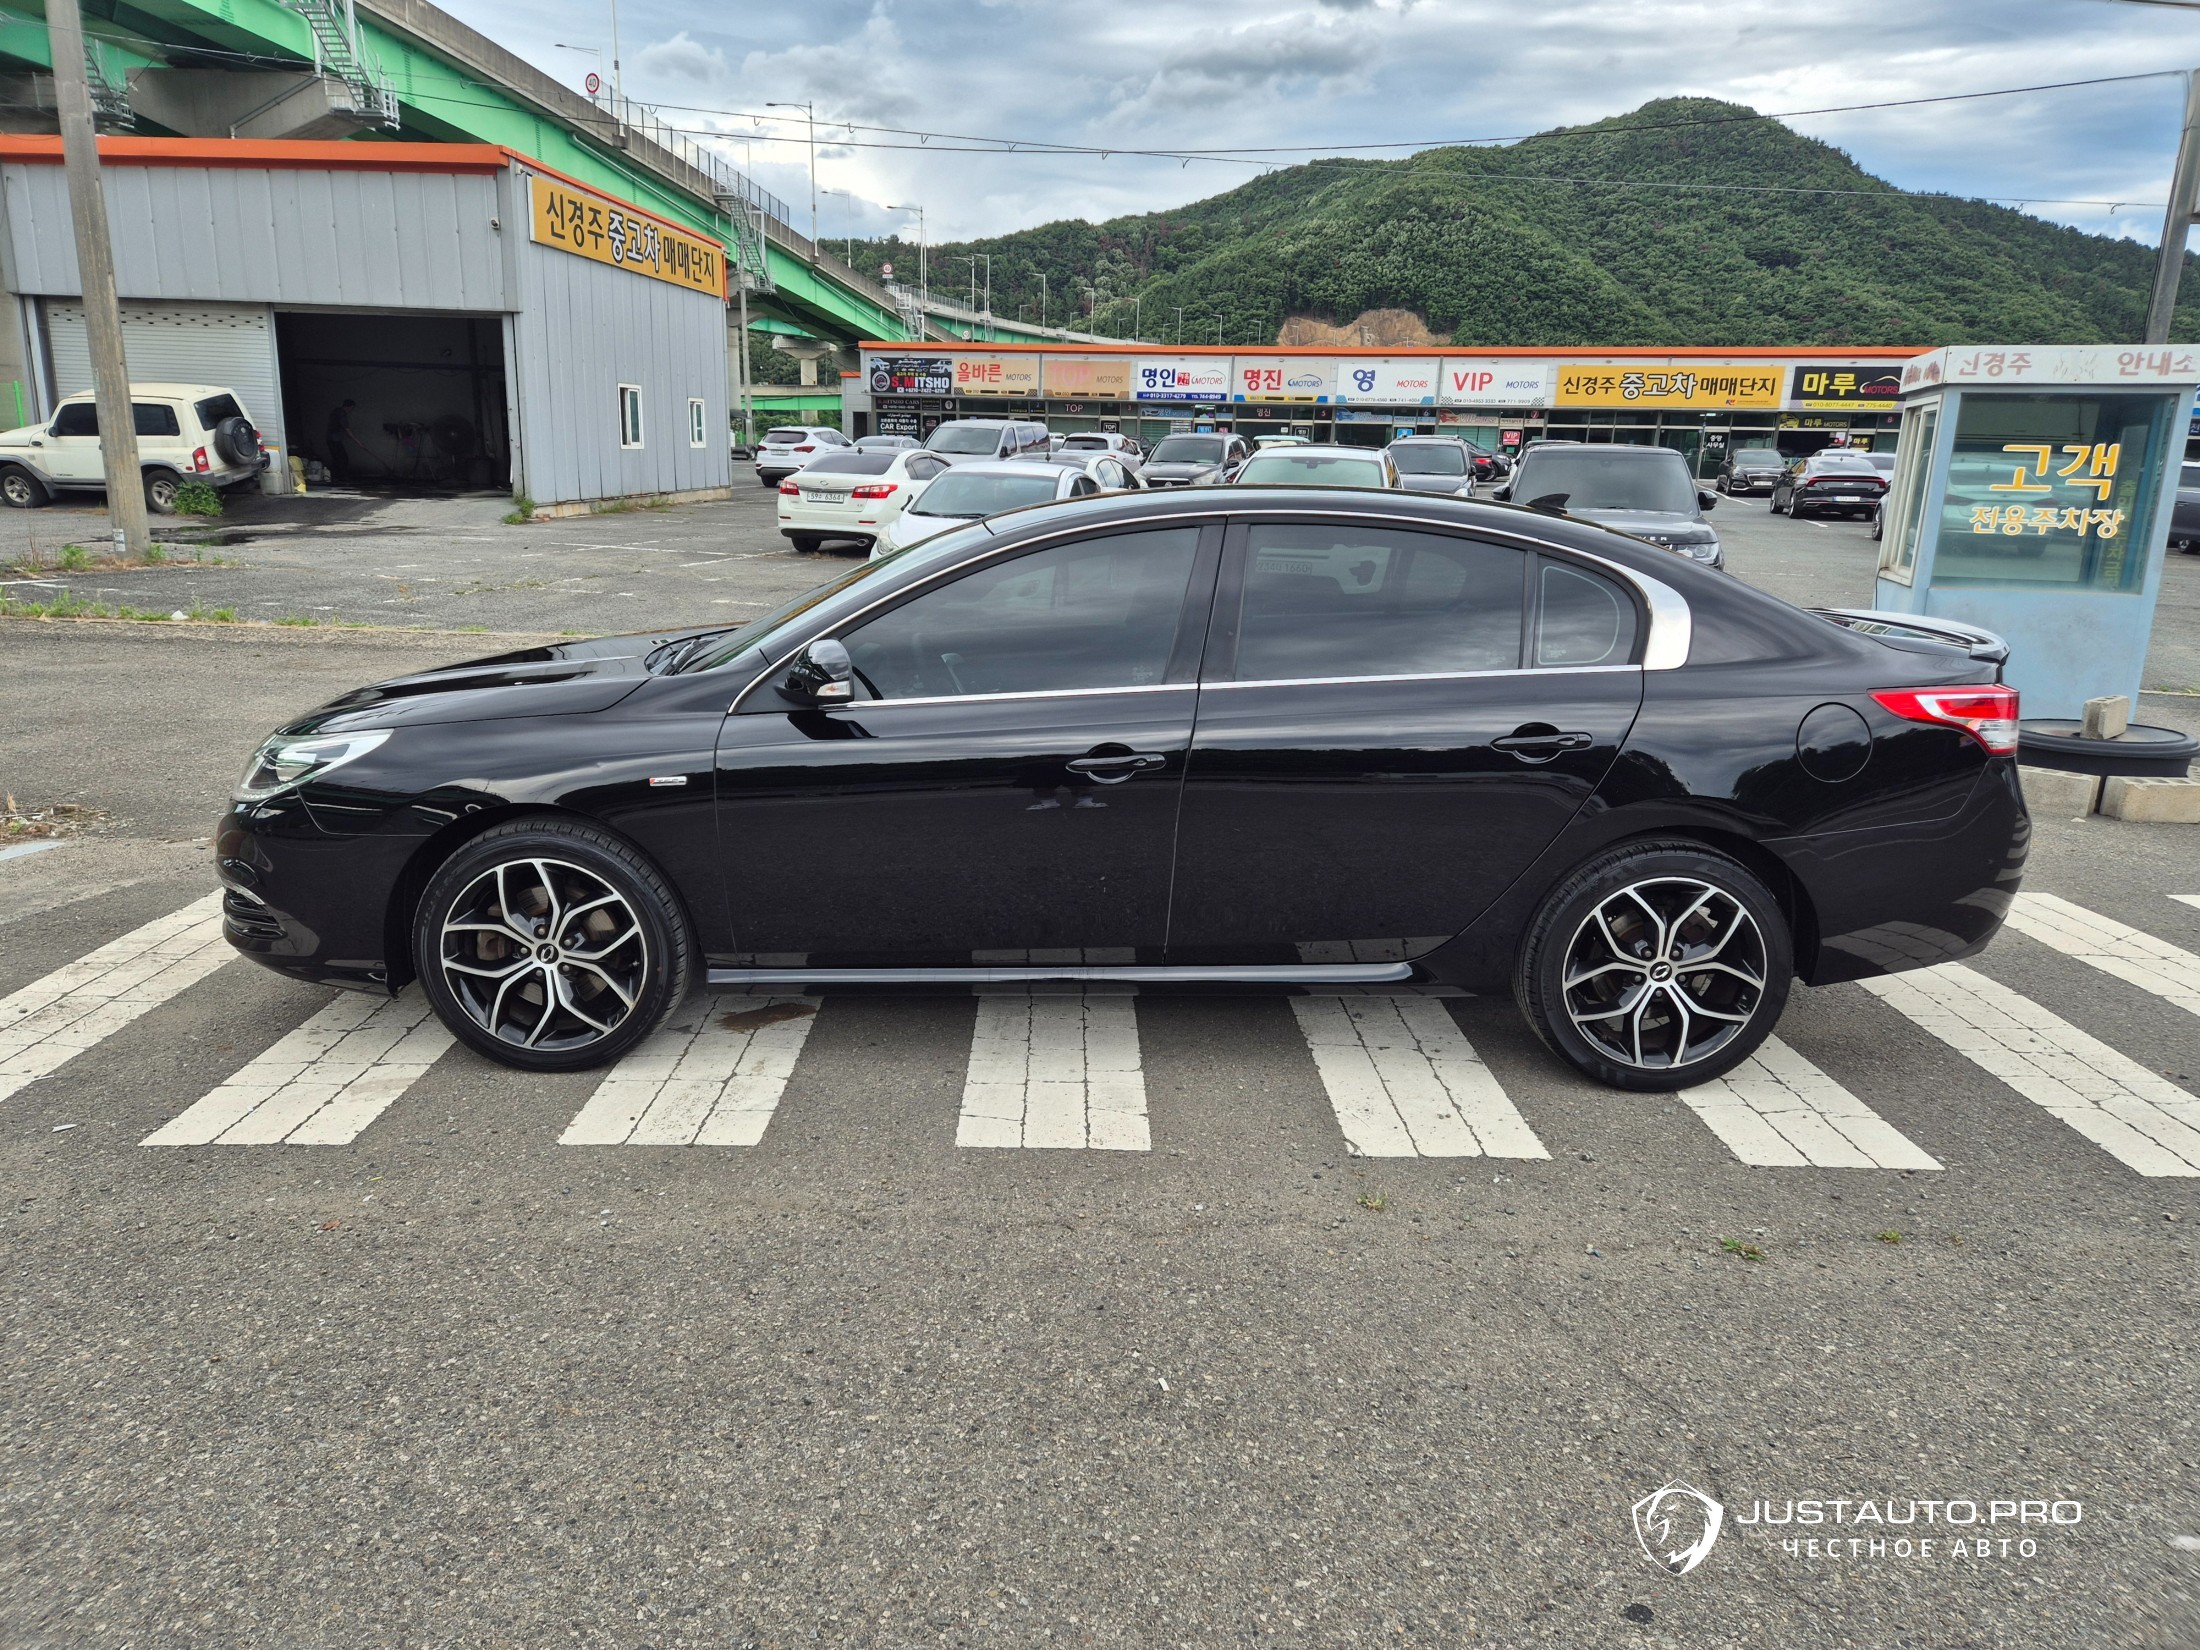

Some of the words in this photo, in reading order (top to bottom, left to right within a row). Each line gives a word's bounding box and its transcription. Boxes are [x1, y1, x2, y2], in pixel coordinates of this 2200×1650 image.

[546, 191, 605, 250] 신경주
[607, 208, 661, 274] 중고차
[662, 235, 715, 288] 매매단지
[956, 362, 1002, 383] 올바른
[1958, 351, 2032, 377] 신경주
[2116, 350, 2198, 377] 안내소
[1005, 373, 1032, 382] MOTORS
[1096, 375, 1124, 384] MOTORS
[1141, 367, 1176, 388] 명인
[1194, 377, 1223, 385] MOTORS
[1243, 368, 1282, 391] 명진
[1352, 368, 1376, 393] 영
[1396, 379, 1429, 388] MOTORS
[1453, 372, 1493, 391] VIP
[1505, 380, 1540, 389] MOTORS
[1562, 376, 1617, 396] 신경주
[1618, 371, 1699, 400] 중고차
[1699, 377, 1776, 396] 매매단지
[1801, 372, 1857, 396] 마루
[1863, 385, 1898, 395] MOTORS
[1065, 403, 1084, 412] TOP
[1256, 407, 1271, 417] 명진
[896, 423, 918, 431] Export
[1804, 418, 1822, 427] 마루
[1988, 443, 2121, 501] 고객
[1969, 504, 2125, 539] 전용주차장
